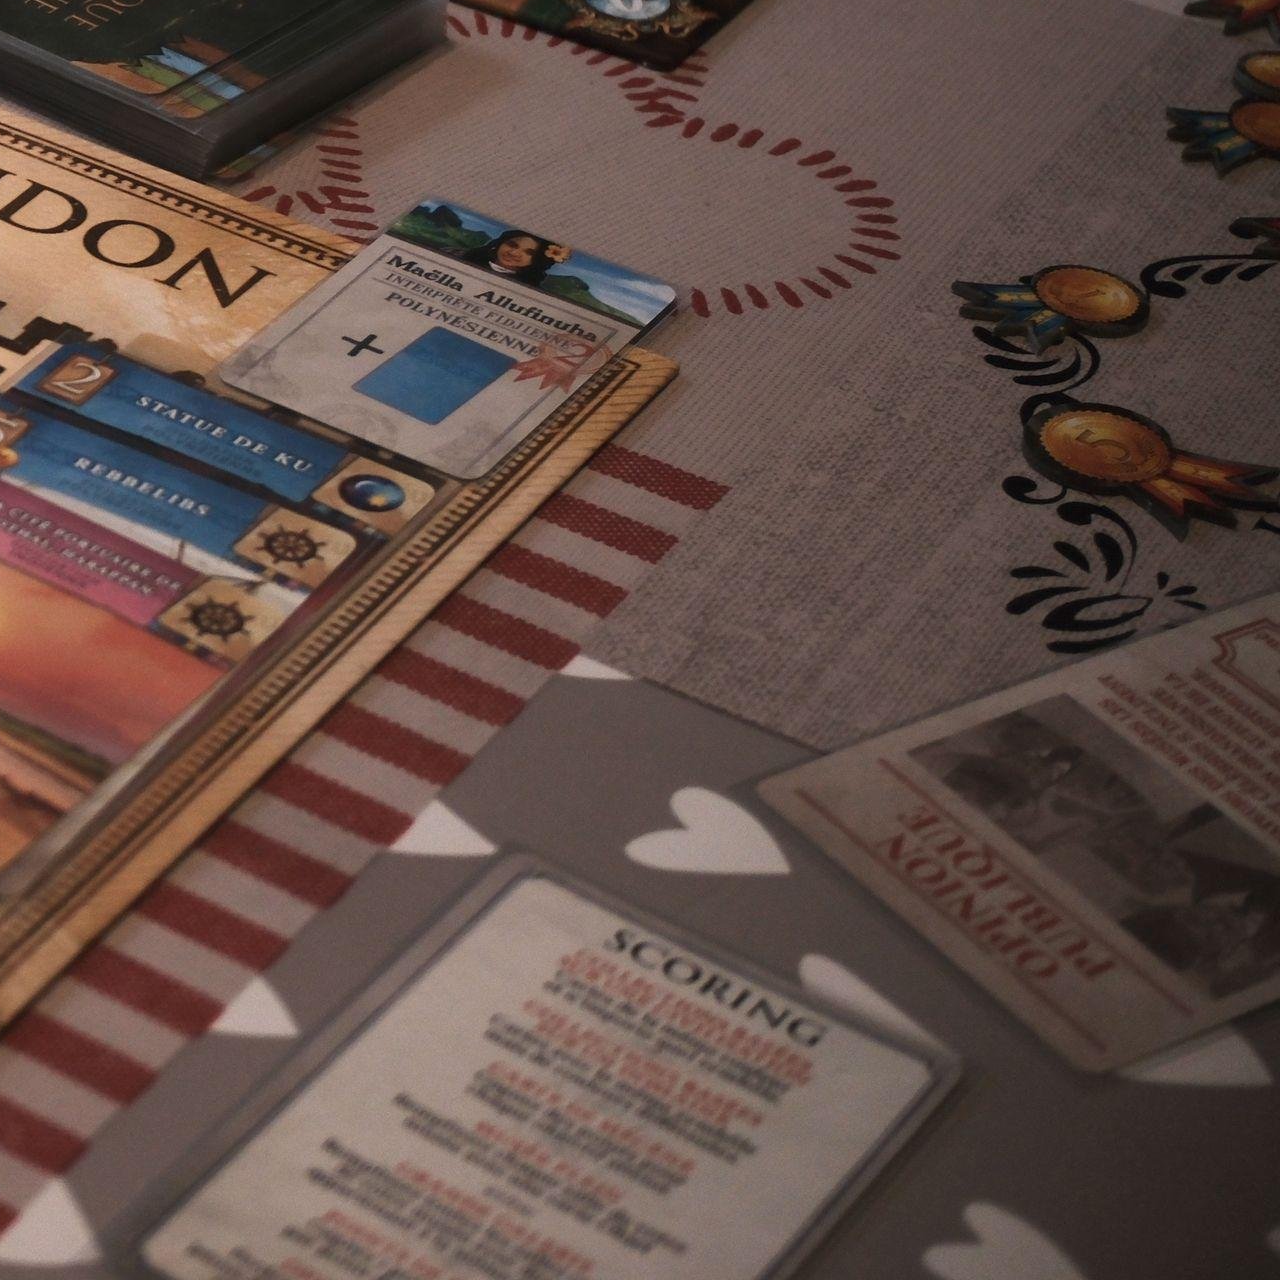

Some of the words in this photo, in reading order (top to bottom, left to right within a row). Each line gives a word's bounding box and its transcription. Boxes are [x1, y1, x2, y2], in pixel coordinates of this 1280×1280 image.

[384, 253, 465, 294] Maëlla
[384, 272, 485, 317] INTERPRÈTE
[485, 309, 574, 350] FIDJIENNE
[383, 291, 539, 359] POLYNÉSIENNE
[53, 363, 103, 395] 2
[135, 395, 228, 442] STATUE
[232, 434, 270, 457] DE
[274, 450, 317, 475] KU
[875, 831, 1060, 980] OPINION
[896, 808, 1117, 980] PUBLIQUE
[604, 928, 828, 1050] SCORING
